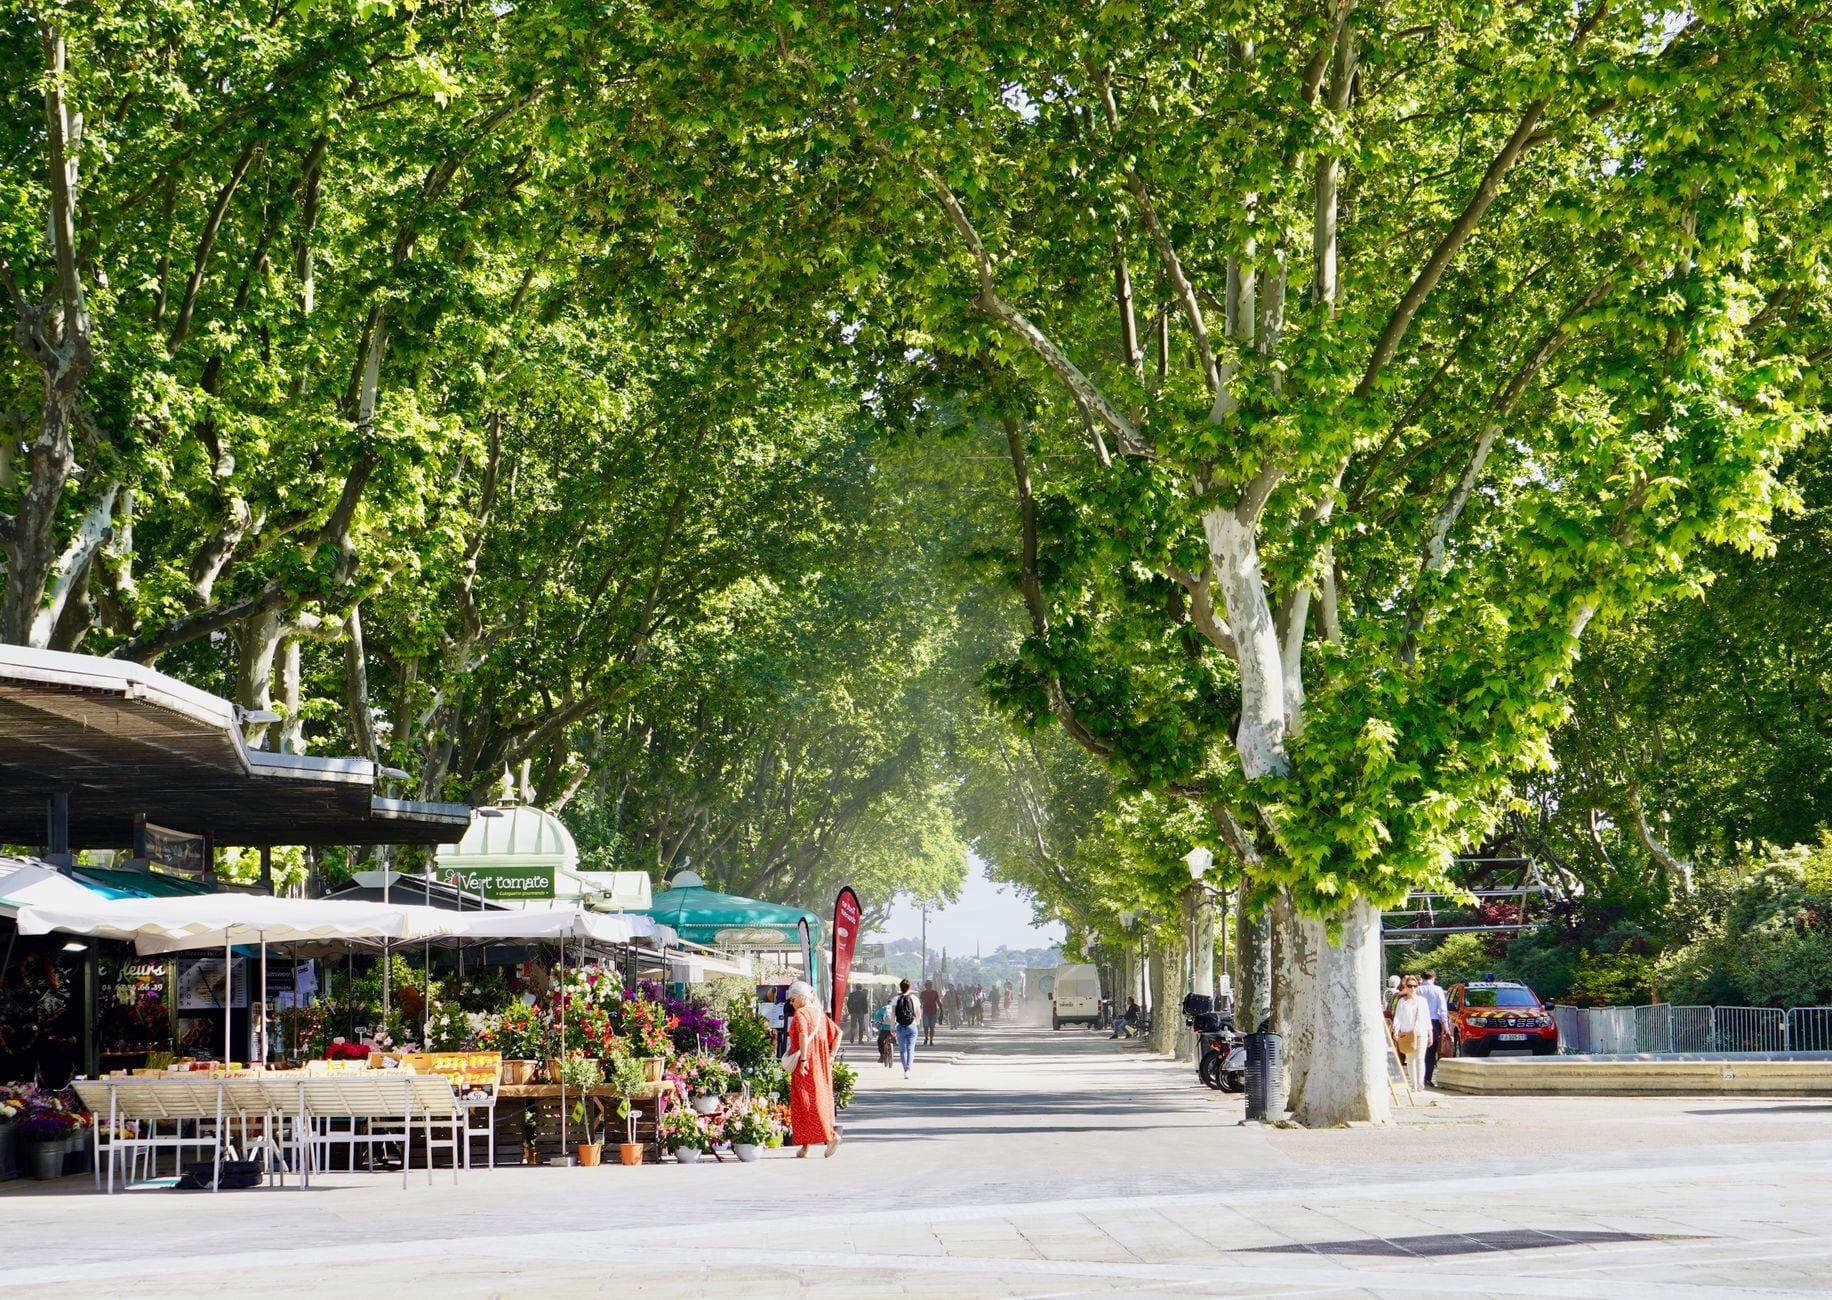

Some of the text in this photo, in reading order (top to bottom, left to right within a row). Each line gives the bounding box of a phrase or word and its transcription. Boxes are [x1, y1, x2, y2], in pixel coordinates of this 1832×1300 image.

[460, 871, 549, 890] Vert tomate
[117, 959, 167, 982] fleurs
